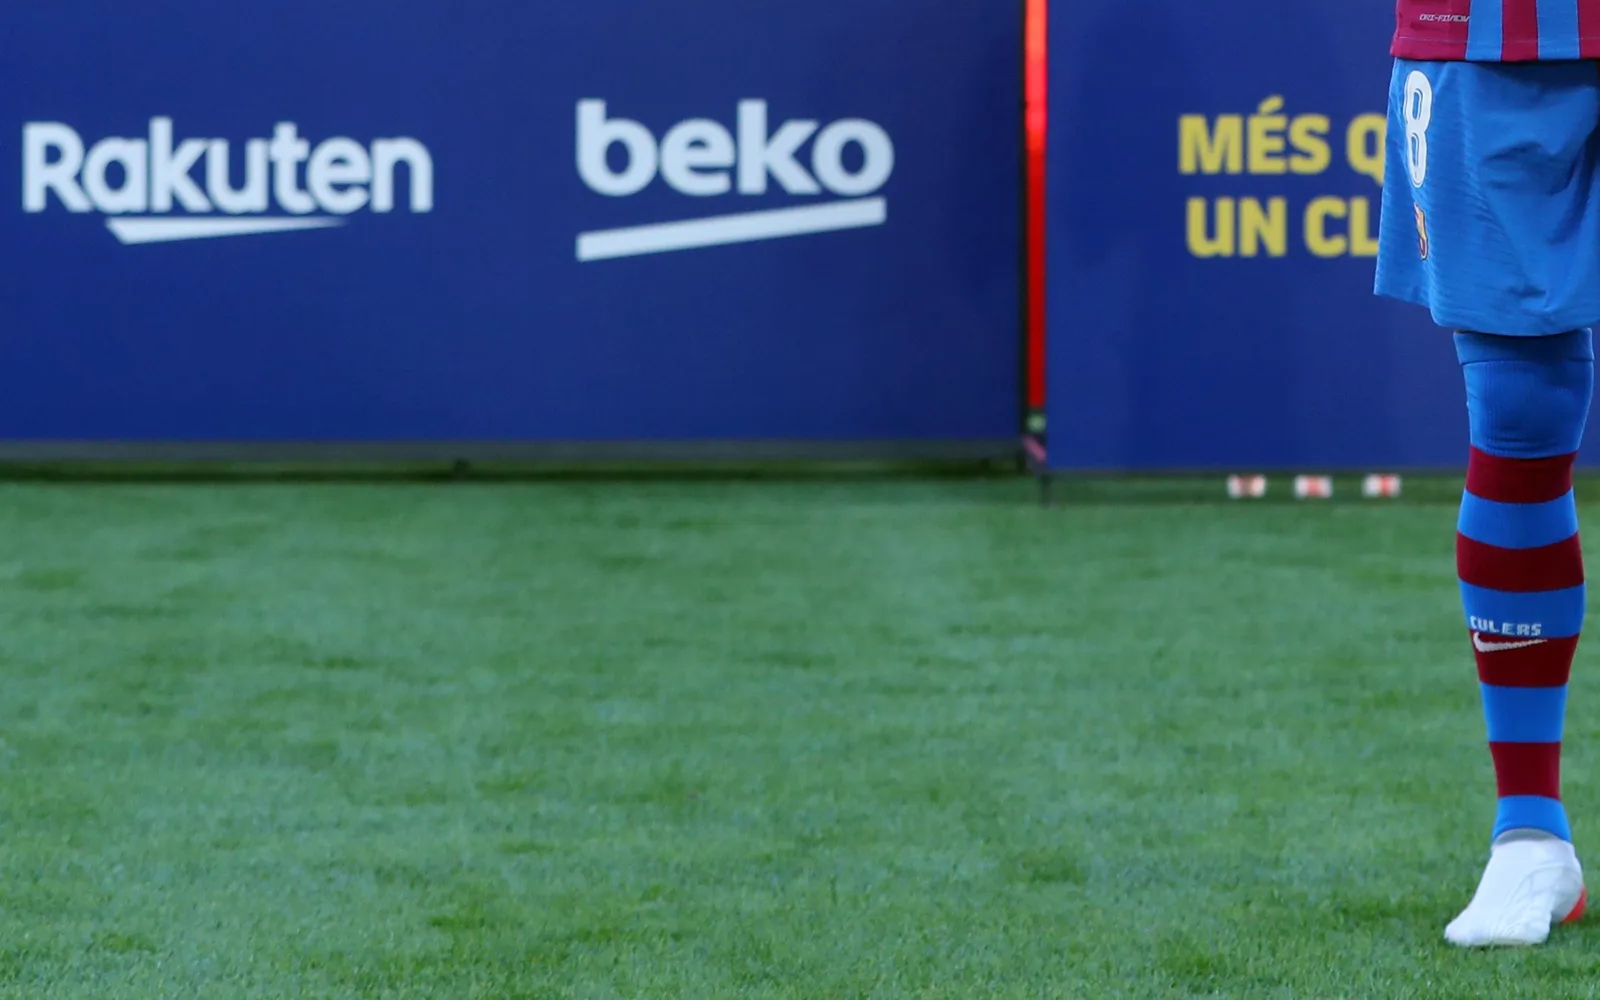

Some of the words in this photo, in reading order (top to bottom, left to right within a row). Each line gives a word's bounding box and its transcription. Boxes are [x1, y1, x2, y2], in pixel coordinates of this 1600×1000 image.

[23, 117, 433, 214] Rakuten
[576, 99, 894, 196] beko
[1178, 95, 1331, 175] MÉS
[1402, 69, 1433, 189] 8
[1186, 196, 1287, 258] UN
[1470, 615, 1542, 637] CULERS
